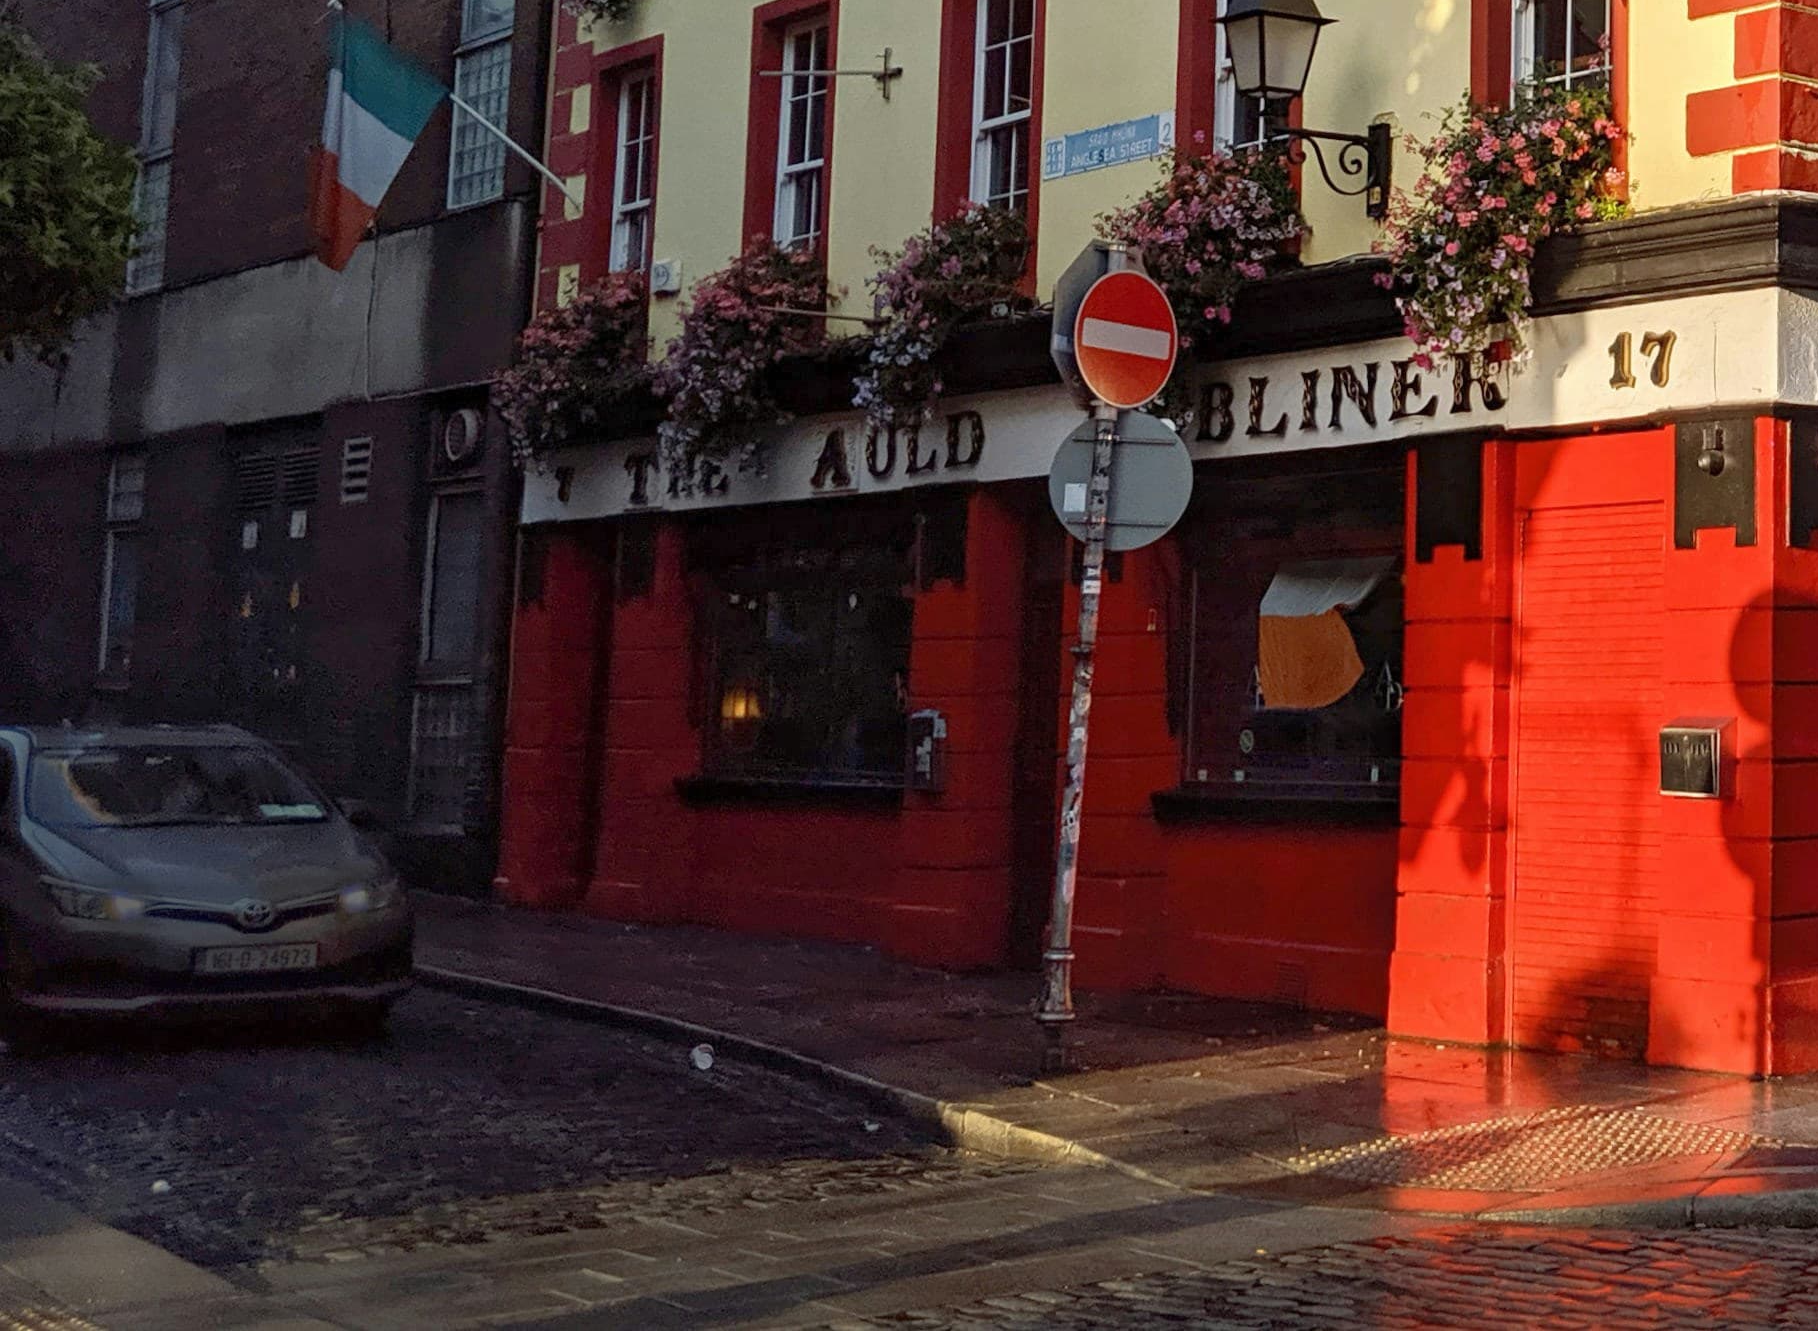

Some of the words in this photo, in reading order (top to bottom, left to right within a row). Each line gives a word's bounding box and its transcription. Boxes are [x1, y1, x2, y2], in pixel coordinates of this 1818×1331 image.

[1120, 137, 1153, 158] STREET
[1162, 122, 1172, 143] 2
[1608, 328, 1677, 389] 17
[811, 410, 985, 489] AULD
[1195, 350, 1508, 443] BLINER
